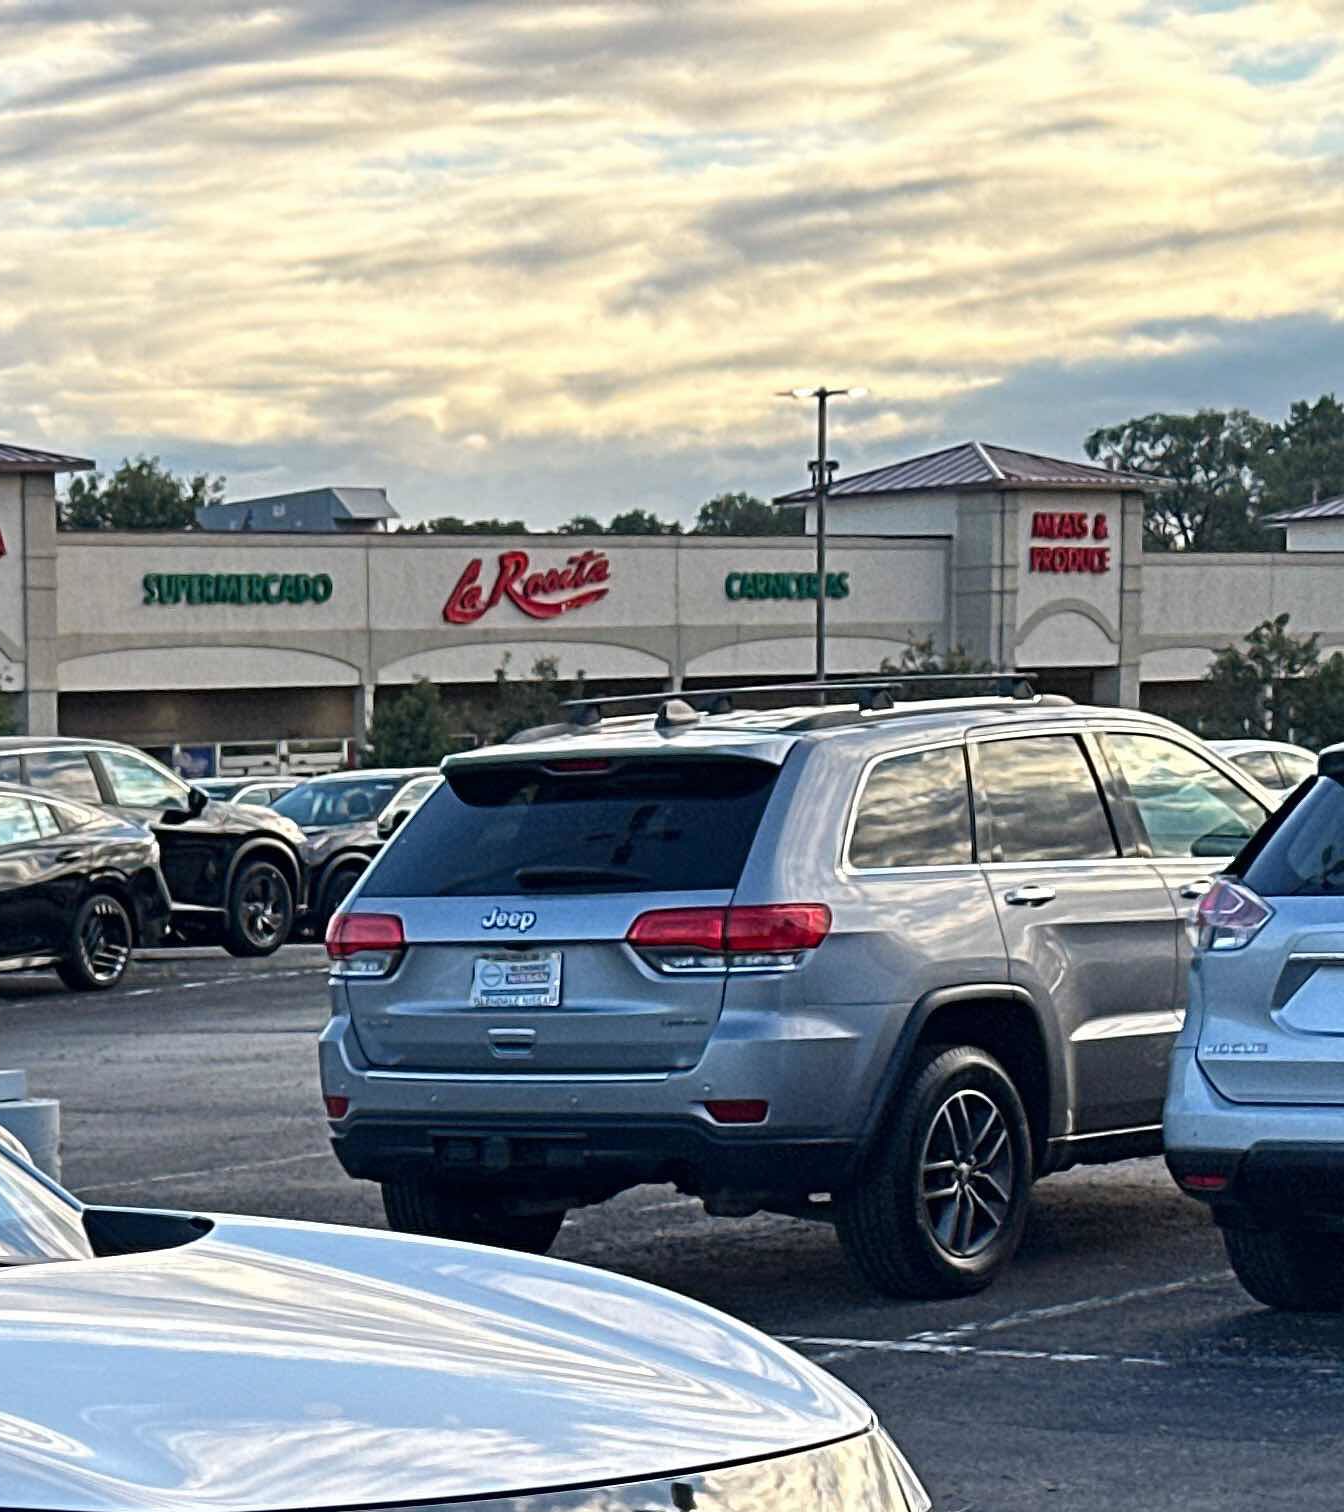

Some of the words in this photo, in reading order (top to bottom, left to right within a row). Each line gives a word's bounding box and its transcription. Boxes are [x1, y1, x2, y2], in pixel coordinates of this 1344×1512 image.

[1031, 512, 1088, 539] MEATS
[1093, 512, 1109, 540] &
[1029, 547, 1111, 574] PRODUCE
[142, 572, 334, 605] SUPERMERCADO
[487, 550, 611, 619] Rosita
[725, 571, 850, 600] CARNICERAS
[481, 906, 537, 933] Jeep
